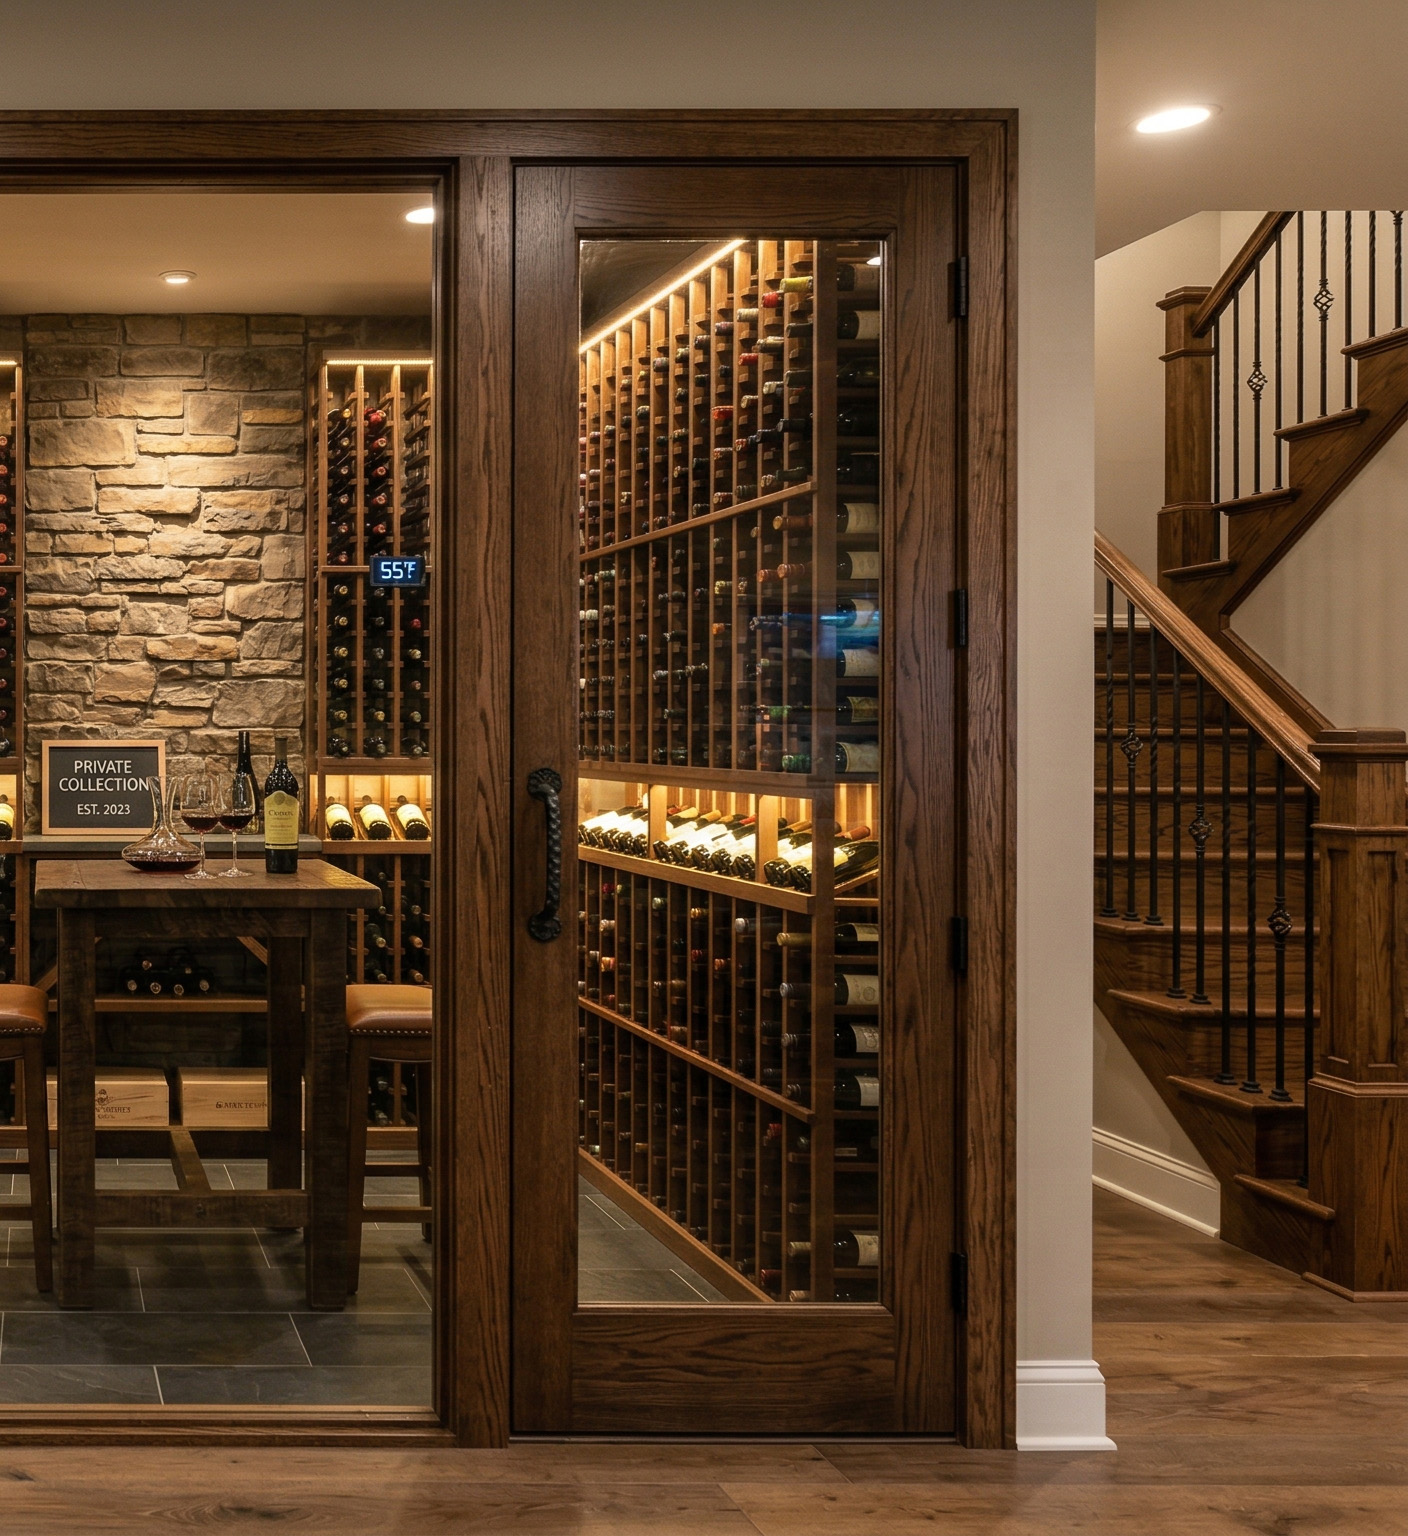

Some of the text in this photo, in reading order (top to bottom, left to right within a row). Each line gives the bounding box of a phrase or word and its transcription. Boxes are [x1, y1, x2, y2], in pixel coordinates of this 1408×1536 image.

[74, 760, 132, 774] PRIVATE
[58, 777, 150, 792] COLLECTION
[77, 804, 131, 815] EST. 2023
